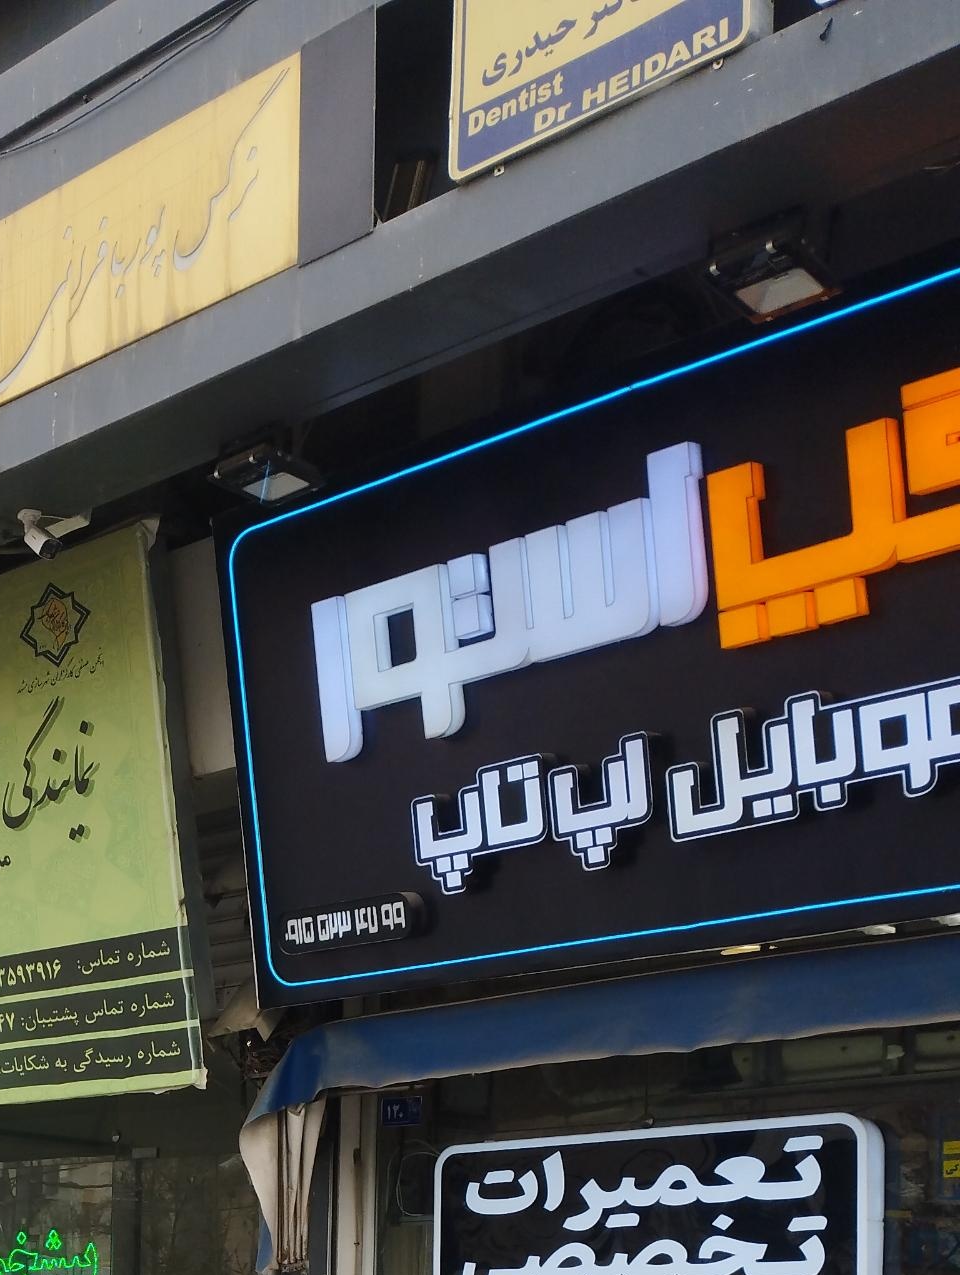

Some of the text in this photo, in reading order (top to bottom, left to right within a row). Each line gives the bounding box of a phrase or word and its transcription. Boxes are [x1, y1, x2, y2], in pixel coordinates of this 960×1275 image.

[482, 19, 577, 87] حیدری
[533, 102, 571, 134] Dr
[582, 17, 729, 110] HEIDARI
[468, 72, 564, 137] Dentist
[2, 696, 97, 842] نمایندگی
[551, 731, 652, 870] لپ
[412, 753, 547, 894] تاپ
[76, 949, 121, 975] تماس:
[127, 940, 171, 968] شماره
[20, 1005, 79, 1032] پشتیبان:
[85, 1000, 125, 1024] تماس
[130, 991, 175, 1018] شماره
[54, 1059, 68, 1073] به
[73, 1048, 132, 1076] رسیدگی
[137, 1040, 181, 1065] شماره
[464, 1135, 825, 1232] تعمیرات
